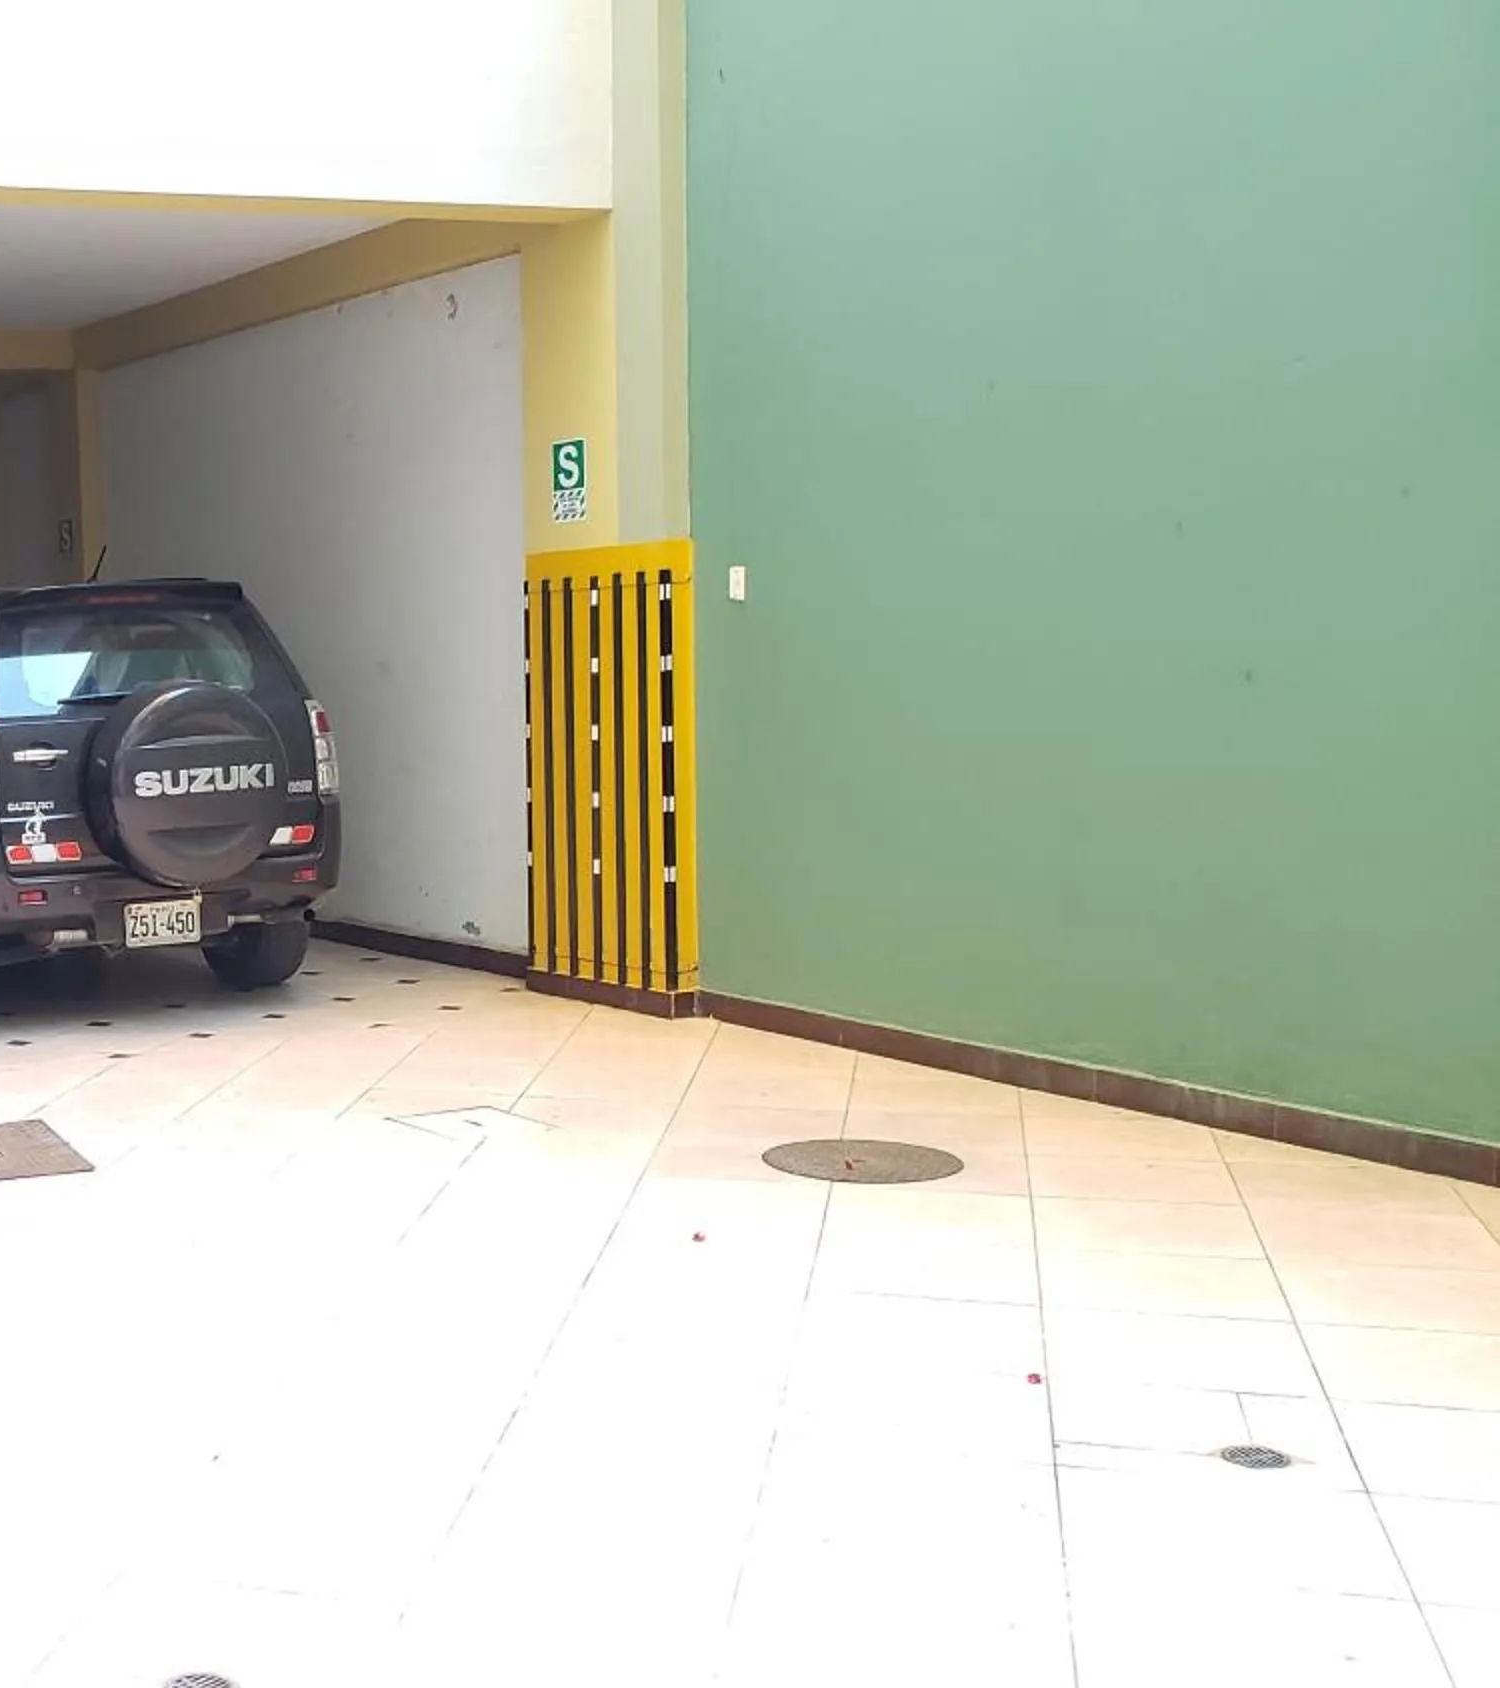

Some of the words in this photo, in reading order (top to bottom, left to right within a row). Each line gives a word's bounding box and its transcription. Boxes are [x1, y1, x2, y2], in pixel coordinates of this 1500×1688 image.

[558, 444, 579, 488] S
[134, 763, 275, 797] SUZUKI
[130, 911, 195, 938] Z51-450
